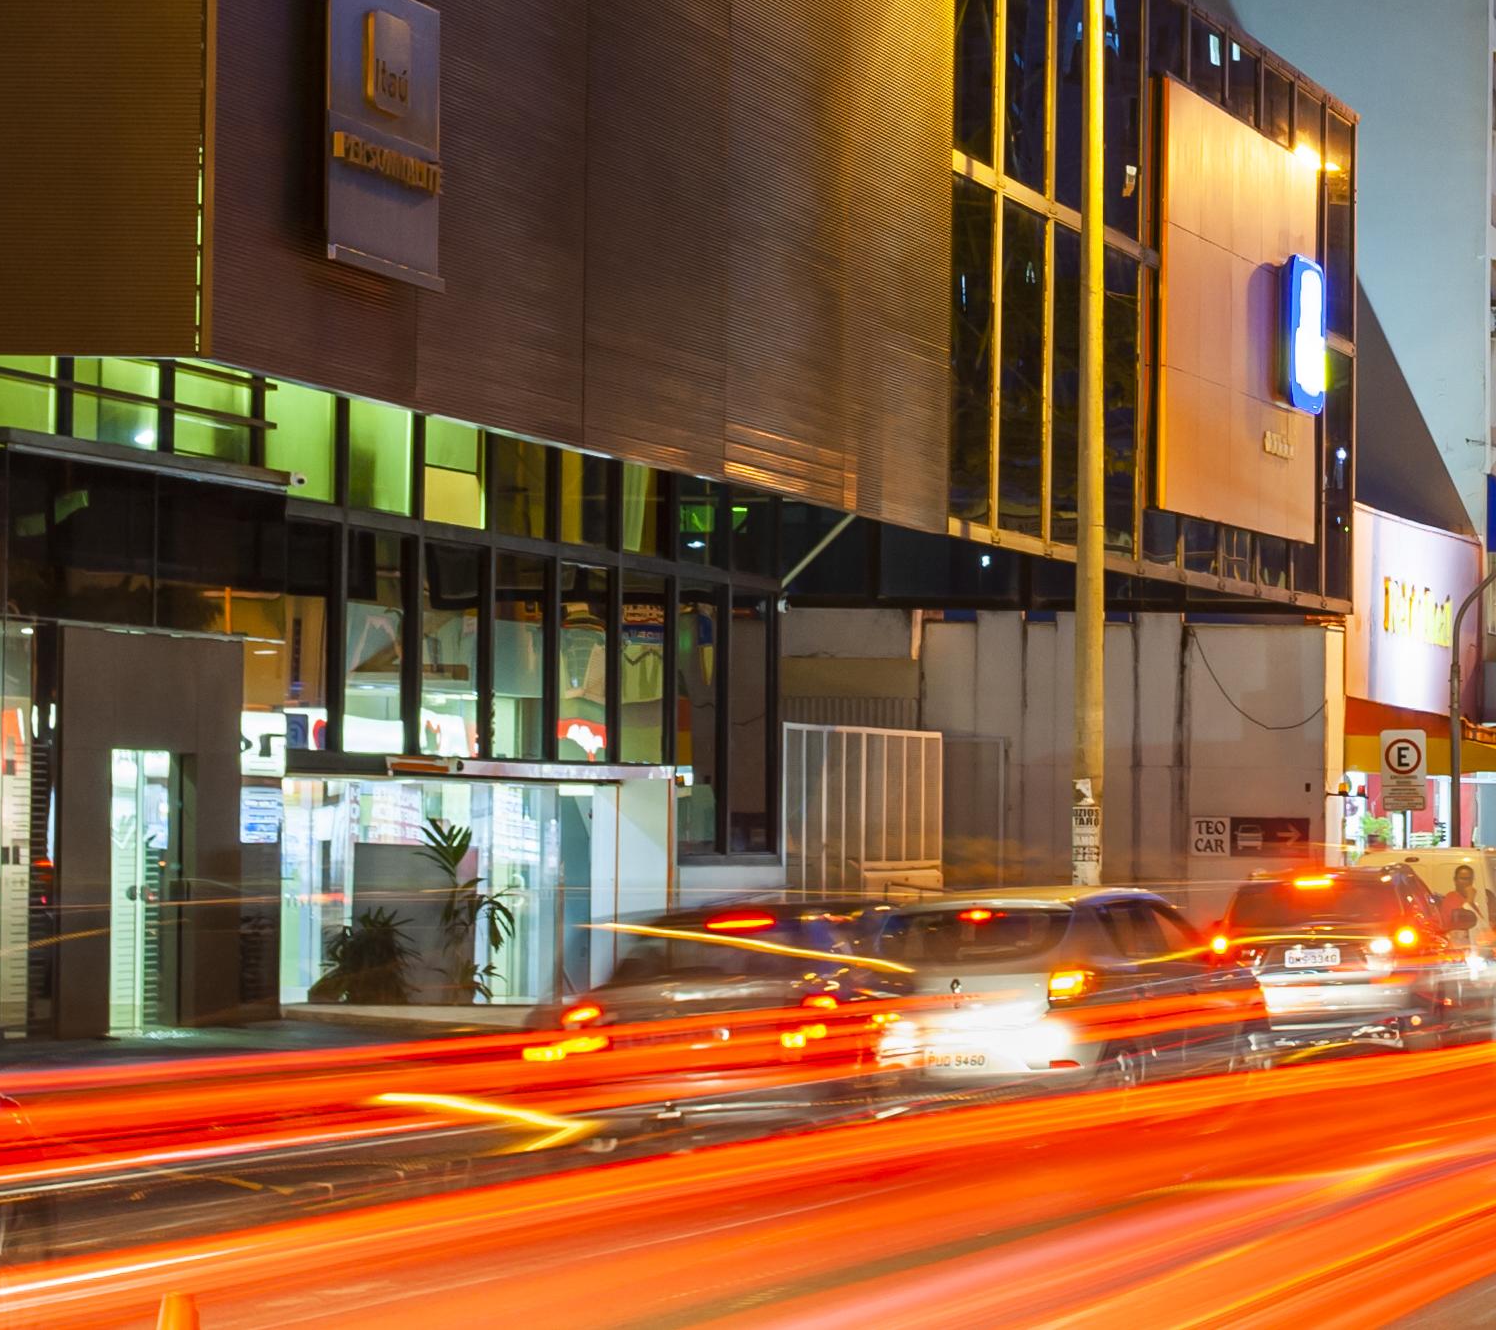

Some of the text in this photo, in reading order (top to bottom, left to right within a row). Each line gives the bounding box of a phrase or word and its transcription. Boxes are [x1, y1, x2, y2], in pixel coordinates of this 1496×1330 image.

[375, 57, 408, 102] Itaú
[1397, 747, 1410, 767] E
[1194, 820, 1226, 836] TEO
[1194, 837, 1225, 853] CAR
